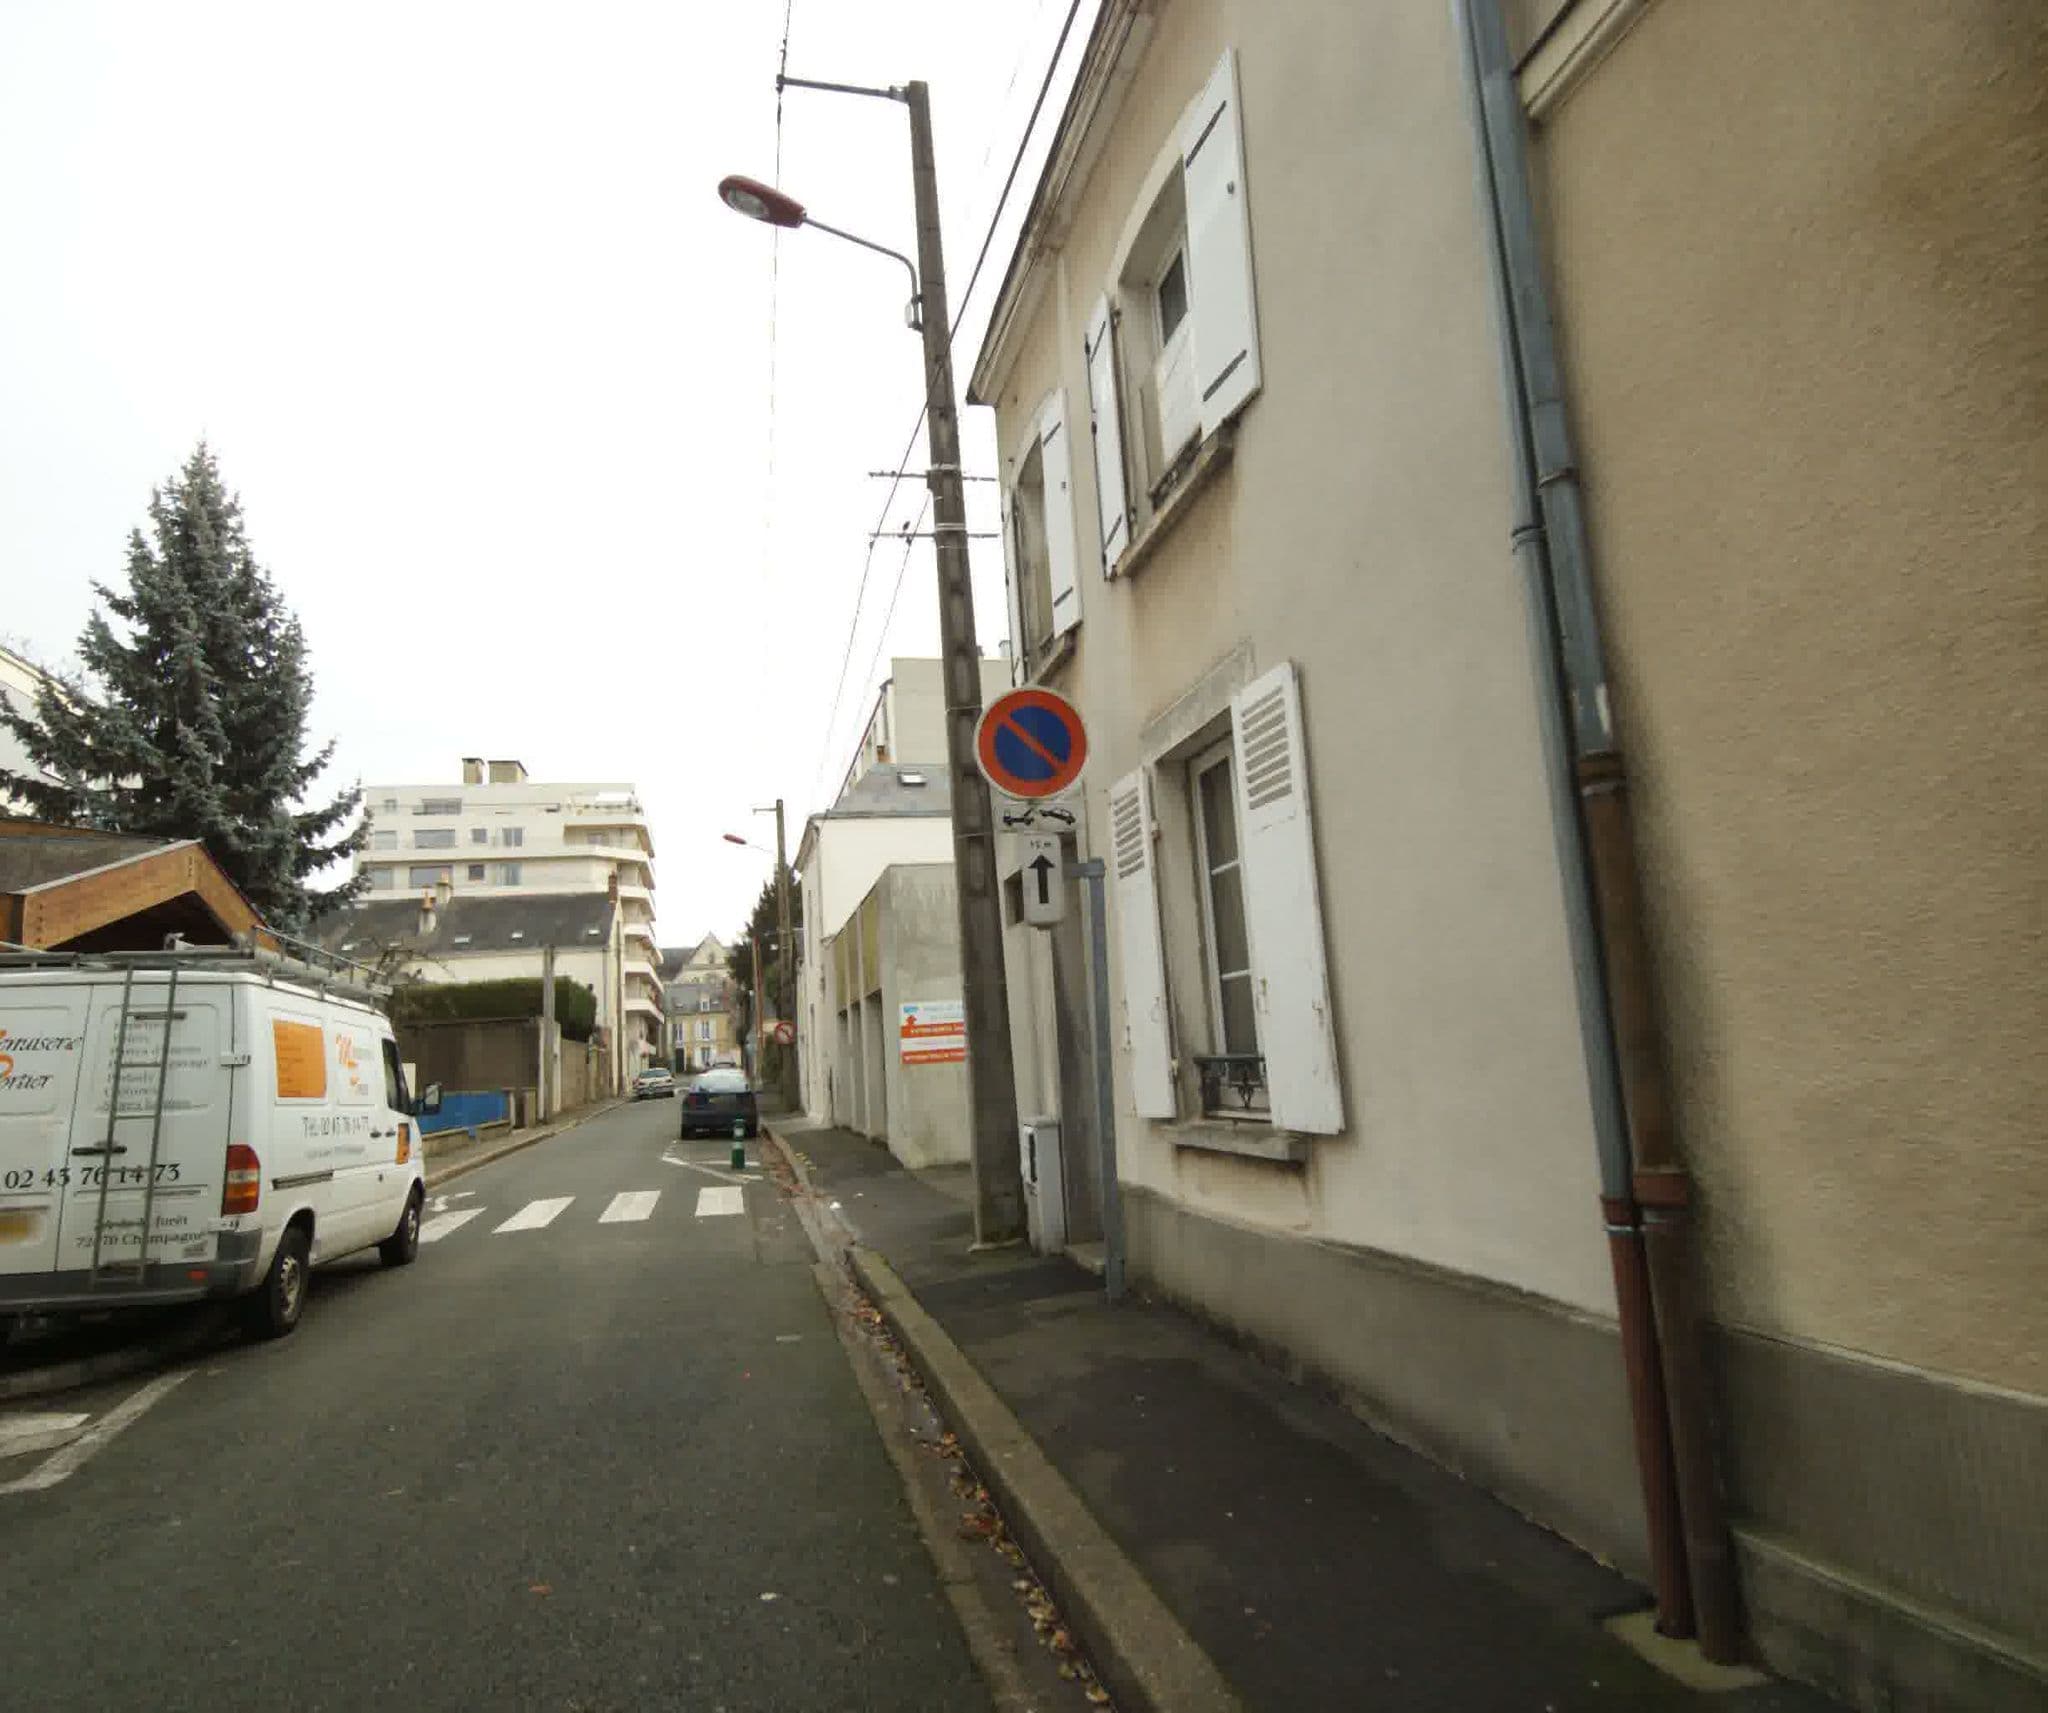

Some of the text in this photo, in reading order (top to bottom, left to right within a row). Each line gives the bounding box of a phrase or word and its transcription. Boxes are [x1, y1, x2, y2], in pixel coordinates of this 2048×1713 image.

[4, 1170, 33, 1188] 02
[118, 1165, 144, 1183] 14
[154, 1163, 180, 1181] 73
